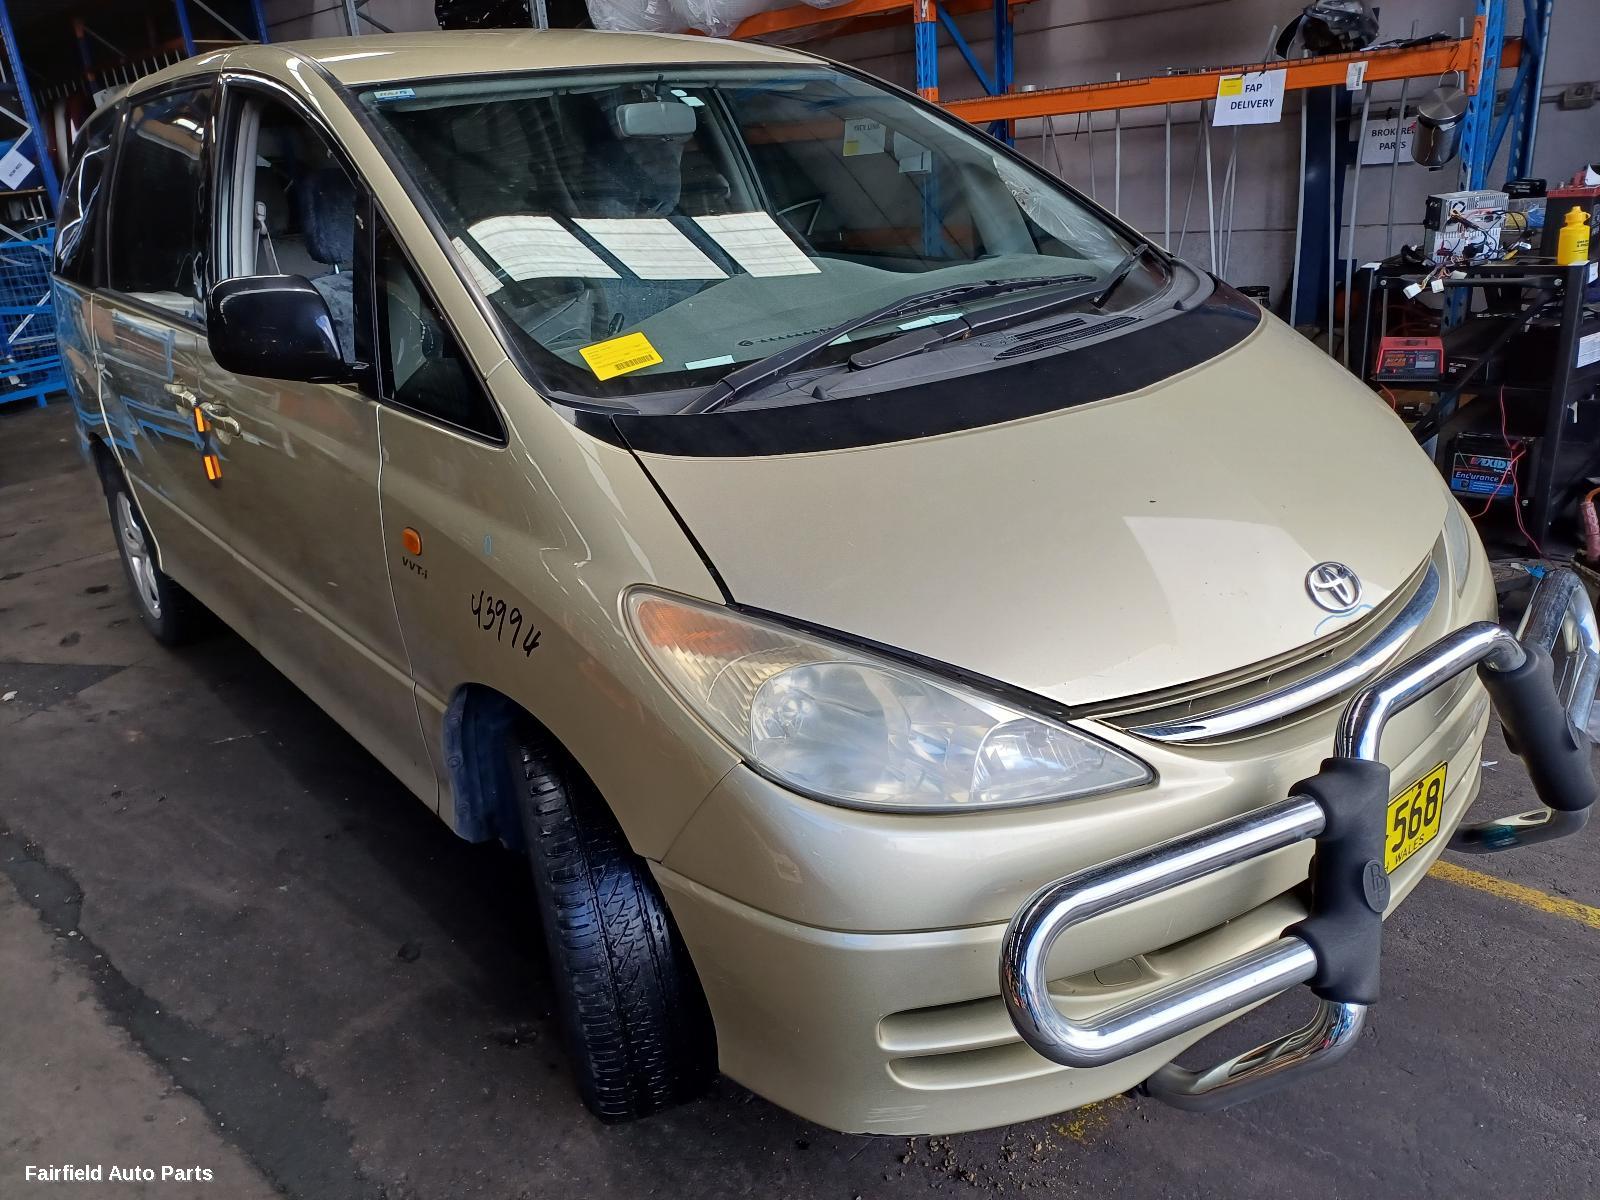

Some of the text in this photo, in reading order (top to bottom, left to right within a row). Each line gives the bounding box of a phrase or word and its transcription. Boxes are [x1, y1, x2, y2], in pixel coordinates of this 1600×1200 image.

[1245, 84, 1263, 93] FAP
[1230, 99, 1275, 110] DELIVERY
[1371, 126, 1415, 137] BROKRE
[1379, 141, 1406, 150] PARS
[471, 590, 541, 657] 43994
[1391, 777, 1441, 853] 568
[1395, 833, 1425, 864] WALES
